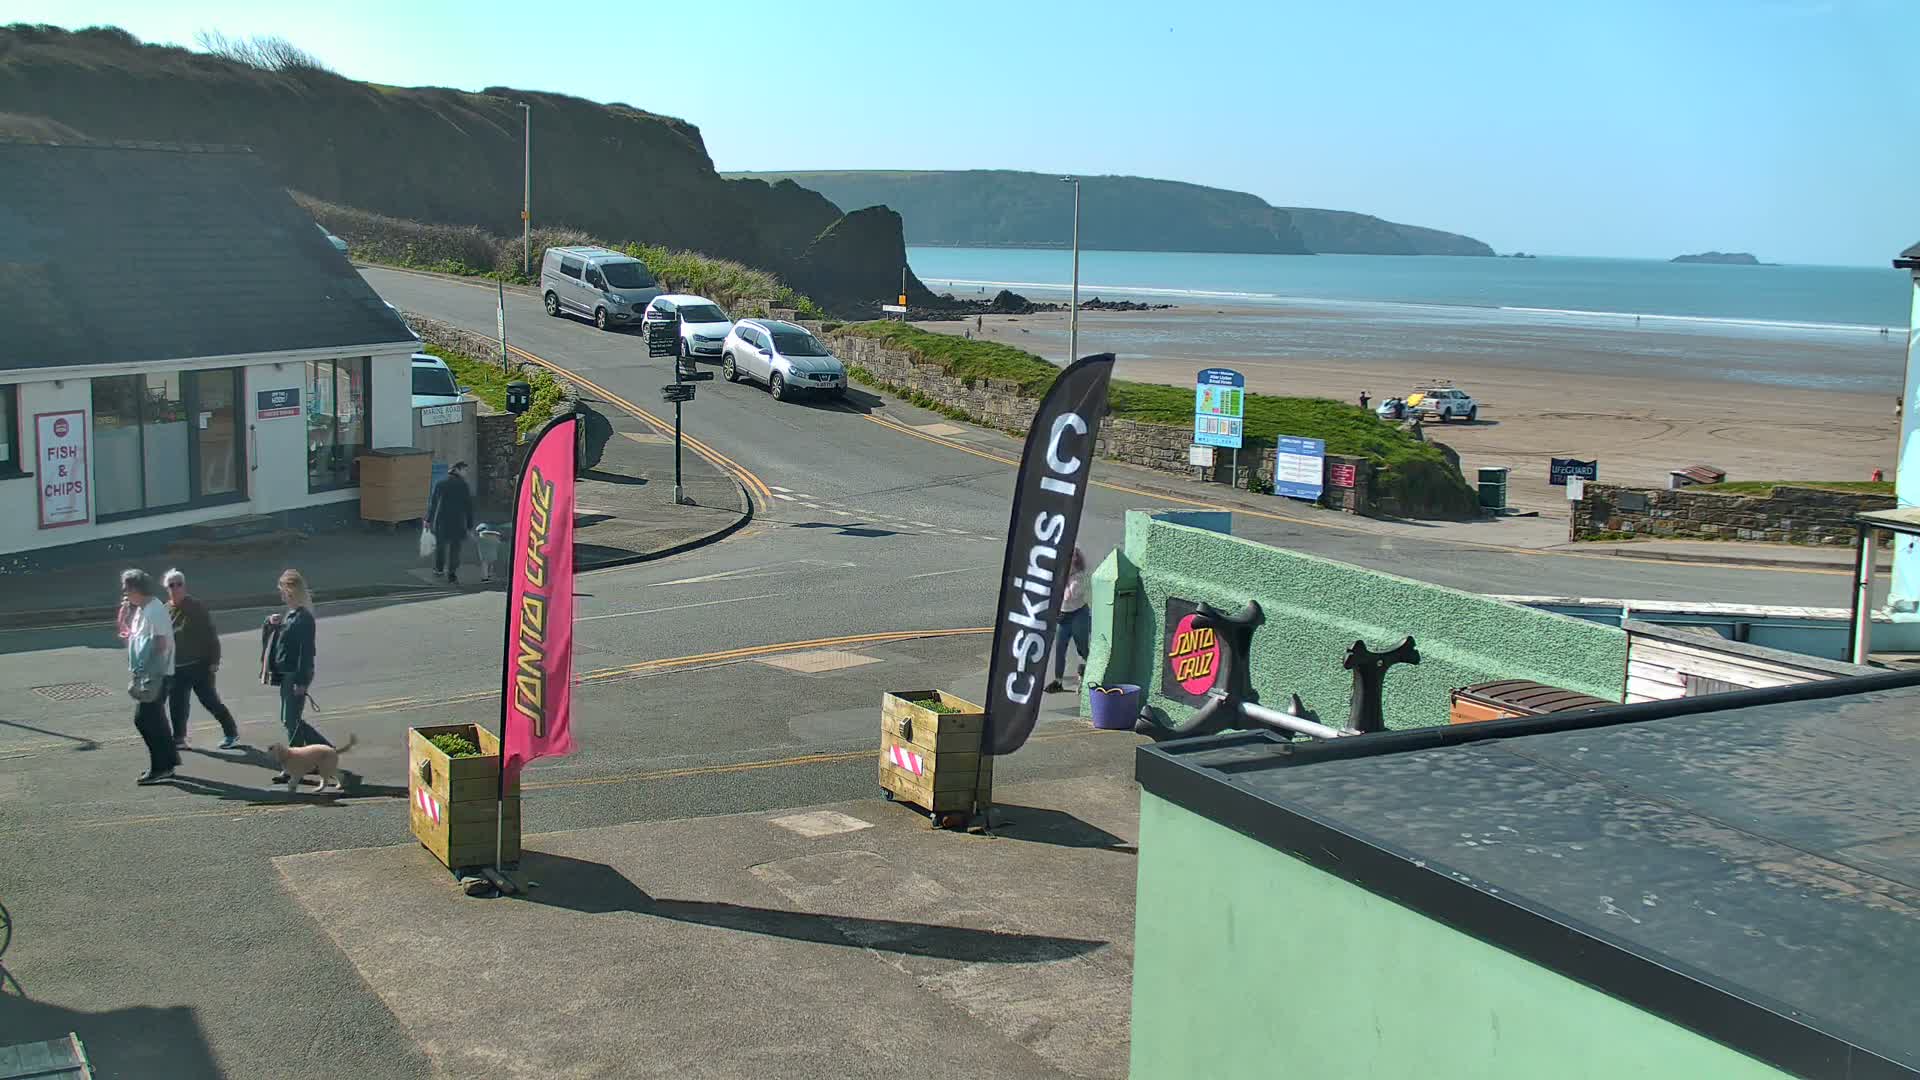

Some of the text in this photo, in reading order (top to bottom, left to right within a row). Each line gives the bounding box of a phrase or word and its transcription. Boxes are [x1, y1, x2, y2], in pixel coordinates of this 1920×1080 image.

[423, 405, 461, 416] MARINE ROAD
[47, 446, 77, 461] FISH
[58, 464, 67, 477] &
[1551, 465, 1594, 475] LIFEGUARD
[45, 481, 83, 497] CHIPS
[514, 467, 554, 738] SANTA CRUZ
[1168, 627, 1215, 657] SANTA
[1176, 651, 1214, 682] CRUZ
